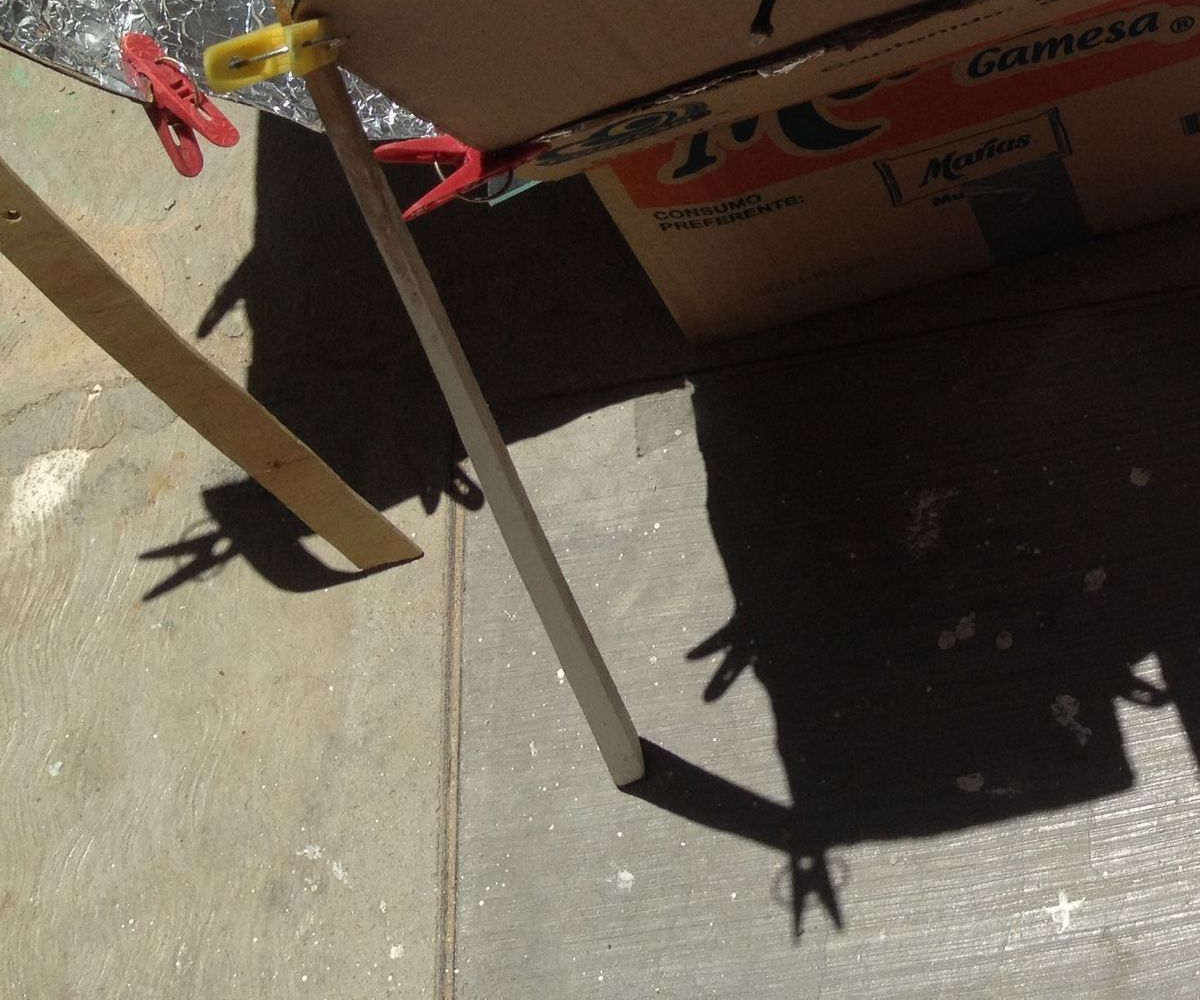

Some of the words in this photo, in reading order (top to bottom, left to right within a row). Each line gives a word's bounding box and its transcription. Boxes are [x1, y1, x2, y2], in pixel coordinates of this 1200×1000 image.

[967, 11, 1160, 79] Gamesa
[653, 193, 762, 221] CONSUMO
[659, 194, 805, 232] PREFERENTE:
